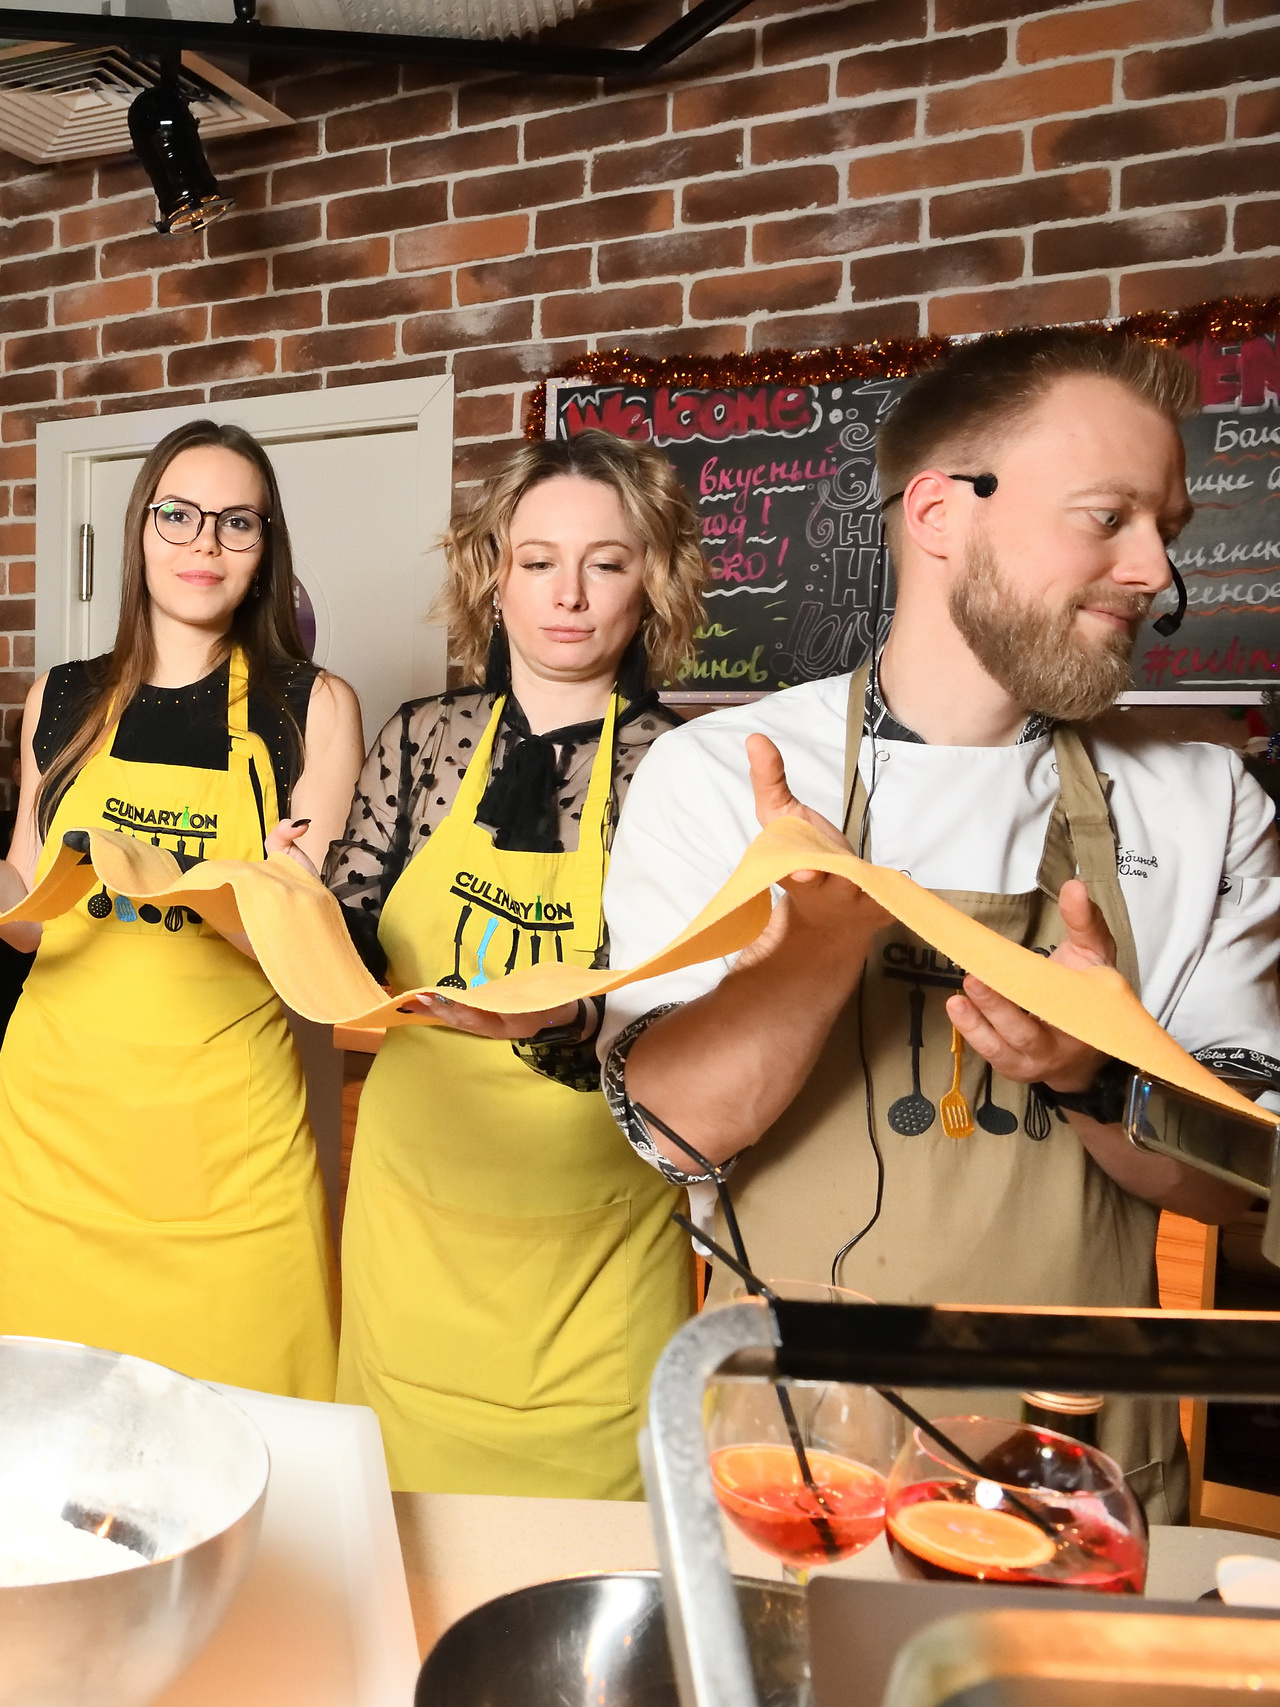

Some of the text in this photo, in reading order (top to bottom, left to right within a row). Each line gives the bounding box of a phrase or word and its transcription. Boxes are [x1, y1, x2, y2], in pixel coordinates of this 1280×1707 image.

[1142, 636, 1280, 686] #culin
[1116, 847, 1158, 868] убинов
[1230, 1048, 1245, 1059] de
